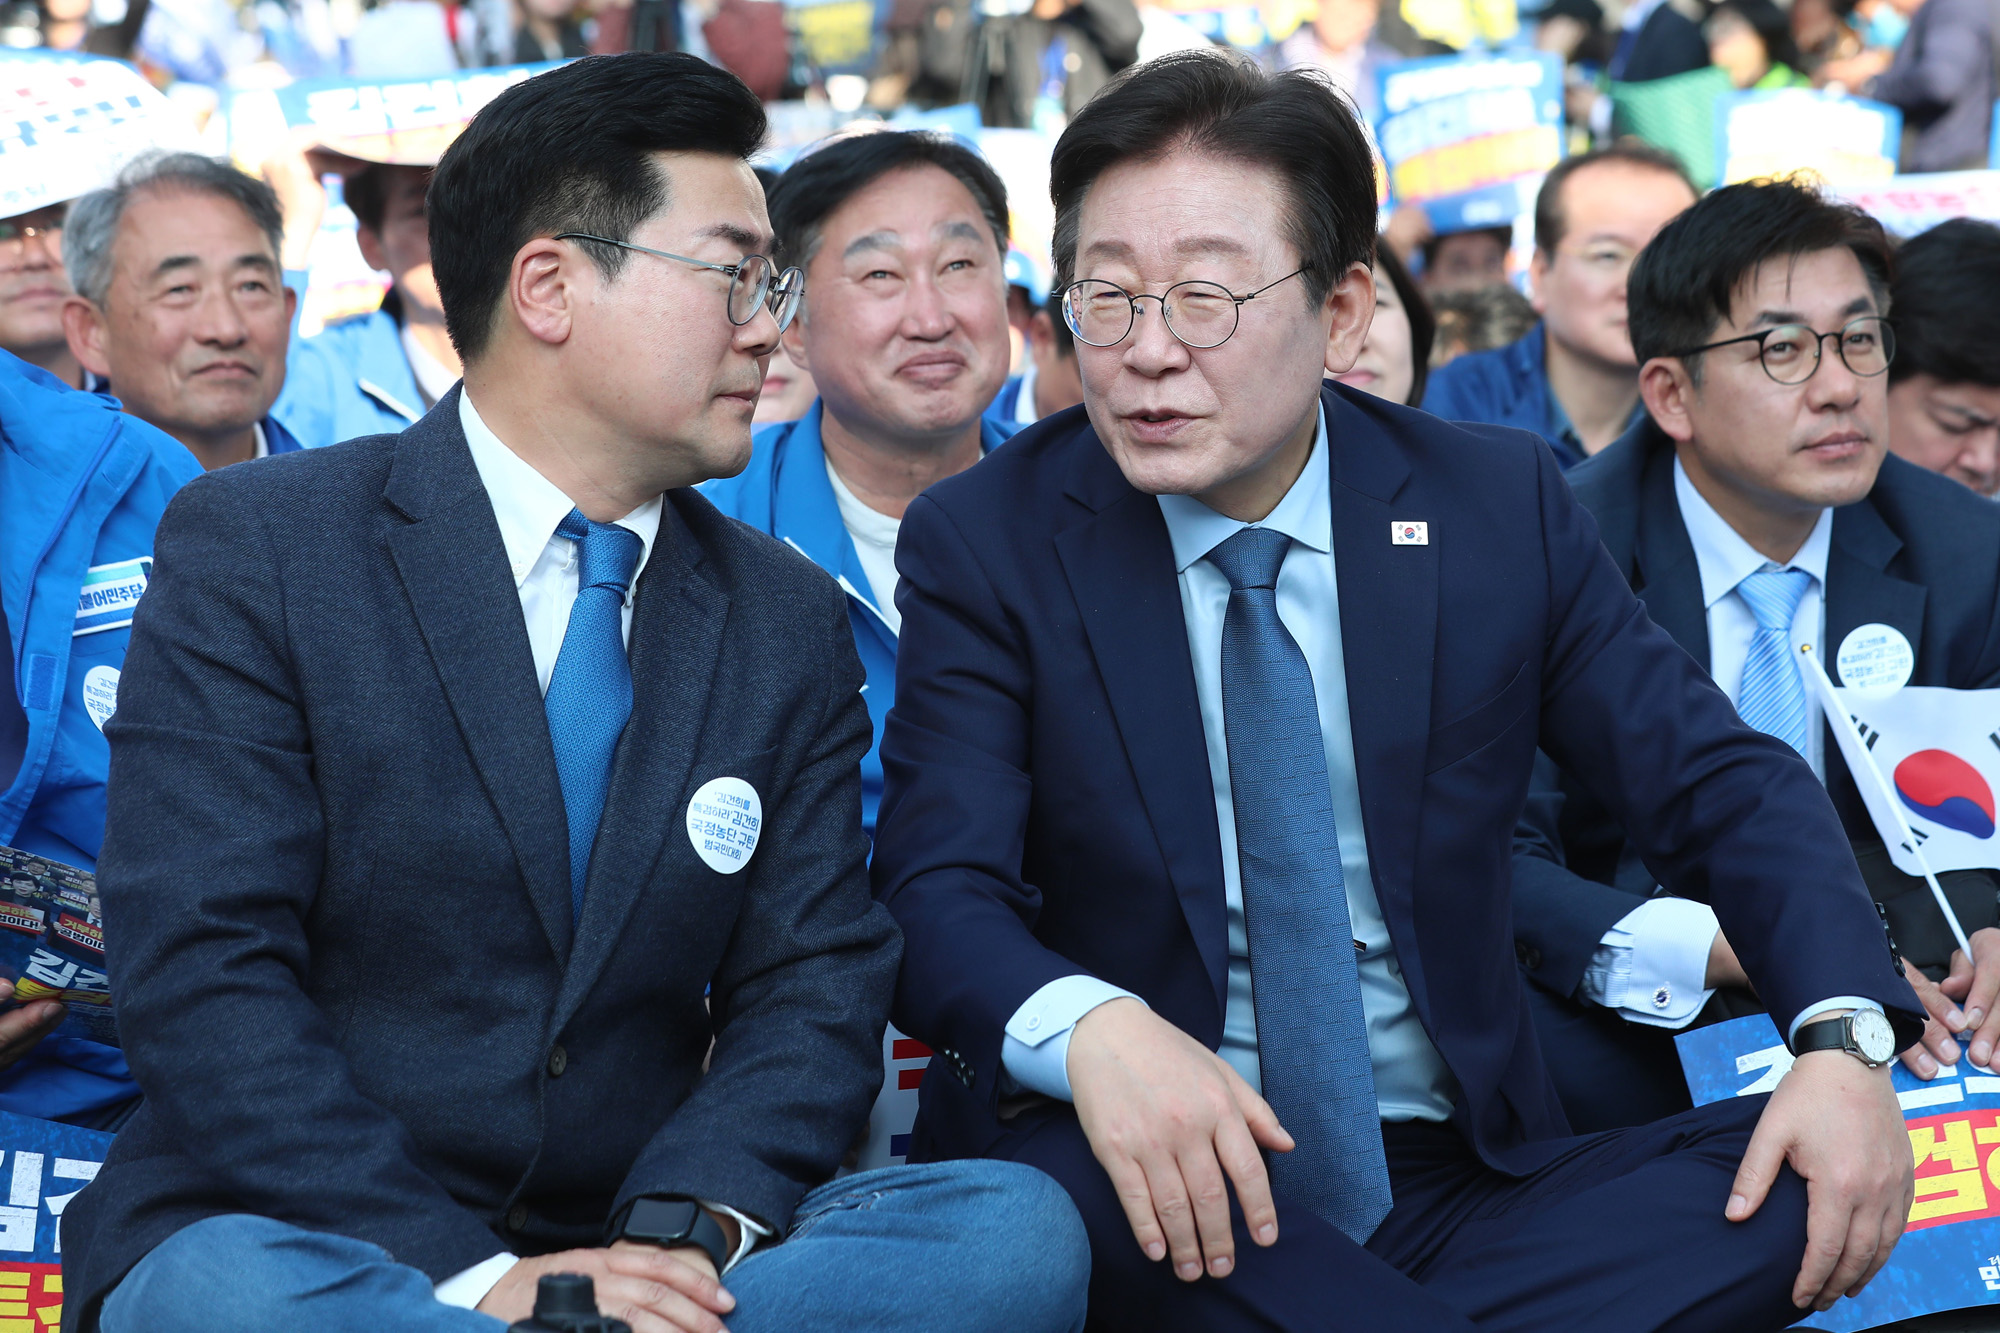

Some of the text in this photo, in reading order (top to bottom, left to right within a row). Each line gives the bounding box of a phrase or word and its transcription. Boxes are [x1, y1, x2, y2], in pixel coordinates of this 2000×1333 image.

[691, 818, 755, 850] 국정농단 규탄
[704, 839, 742, 861] 범국민대회
